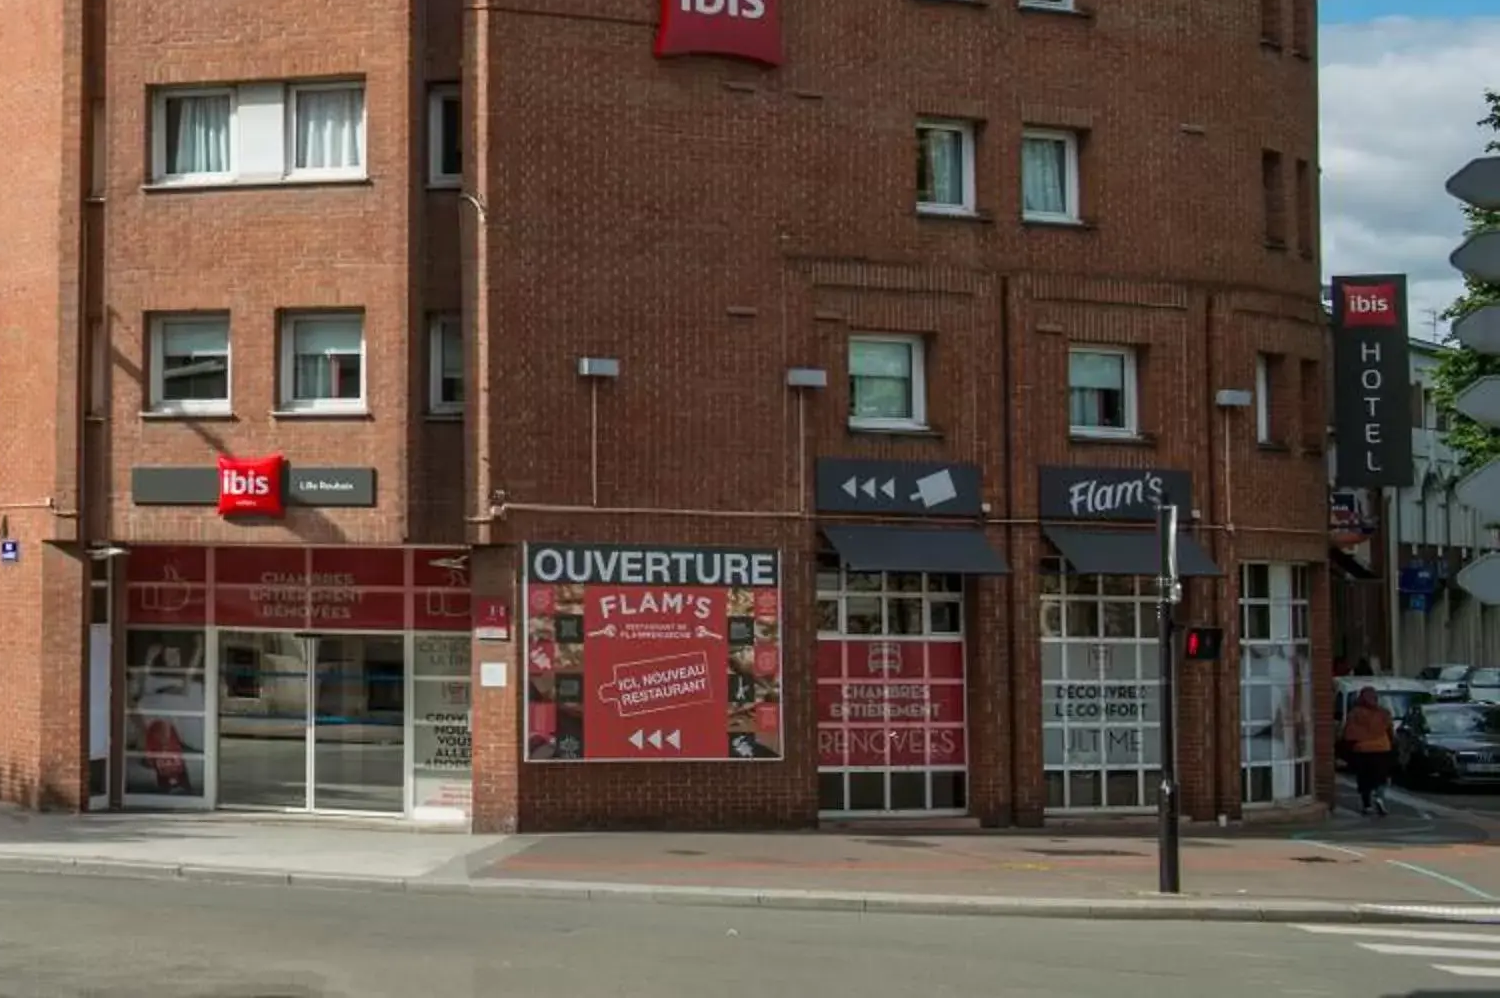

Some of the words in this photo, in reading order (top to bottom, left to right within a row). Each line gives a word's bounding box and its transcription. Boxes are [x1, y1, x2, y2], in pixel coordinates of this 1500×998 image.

[1350, 295, 1389, 312] ibis
[1360, 342, 1383, 472] HOTEL
[222, 469, 269, 495] ibis
[319, 481, 354, 490] Roubaix
[1069, 472, 1163, 516] Flam's
[534, 549, 774, 584] OUVERTURE
[600, 592, 712, 619] FLAM'S
[643, 664, 705, 687] NOUVEAU
[621, 678, 706, 706] RESTAURANT
[841, 685, 930, 699] CHAMBRES
[1055, 703, 1074, 717] LE
[1062, 729, 1141, 754] ULTME
